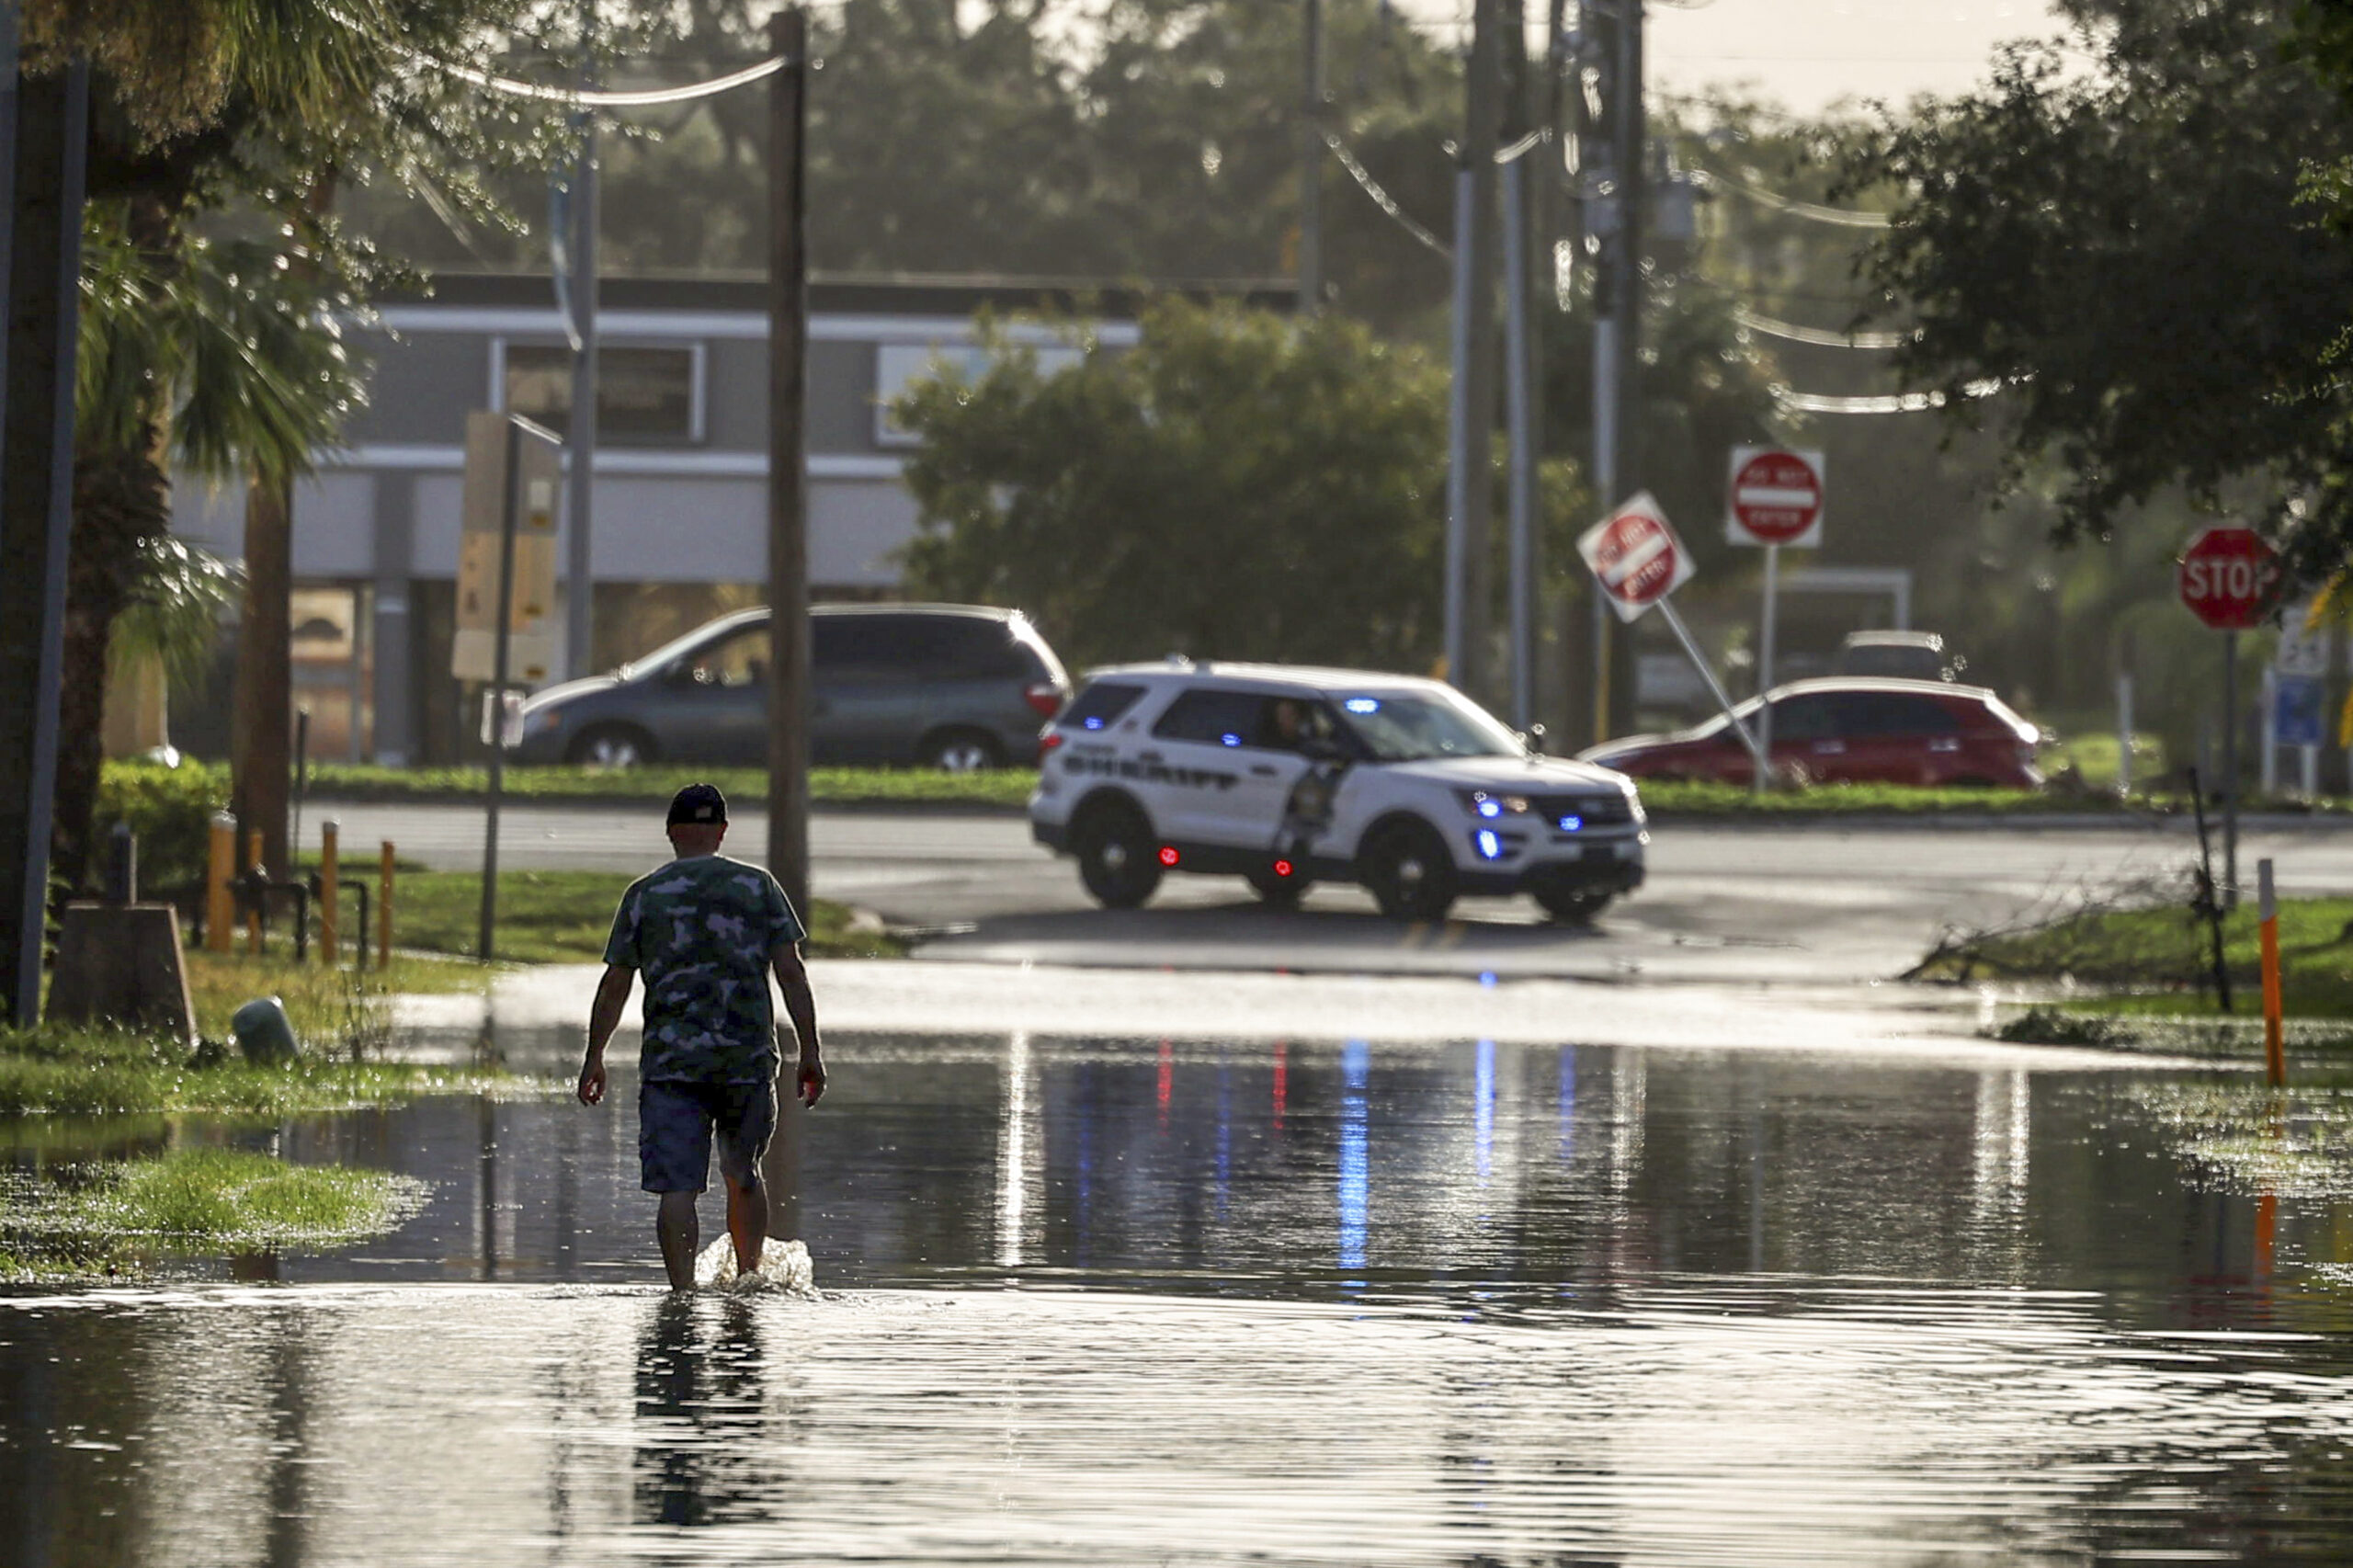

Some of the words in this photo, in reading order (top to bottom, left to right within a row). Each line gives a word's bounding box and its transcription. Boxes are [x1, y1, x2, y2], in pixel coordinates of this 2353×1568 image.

[1619, 519, 1647, 550] NOT
[1624, 559, 1665, 597] ENTER
[2187, 557, 2277, 599] STOP
[1063, 755, 1238, 790] SHERIFF
